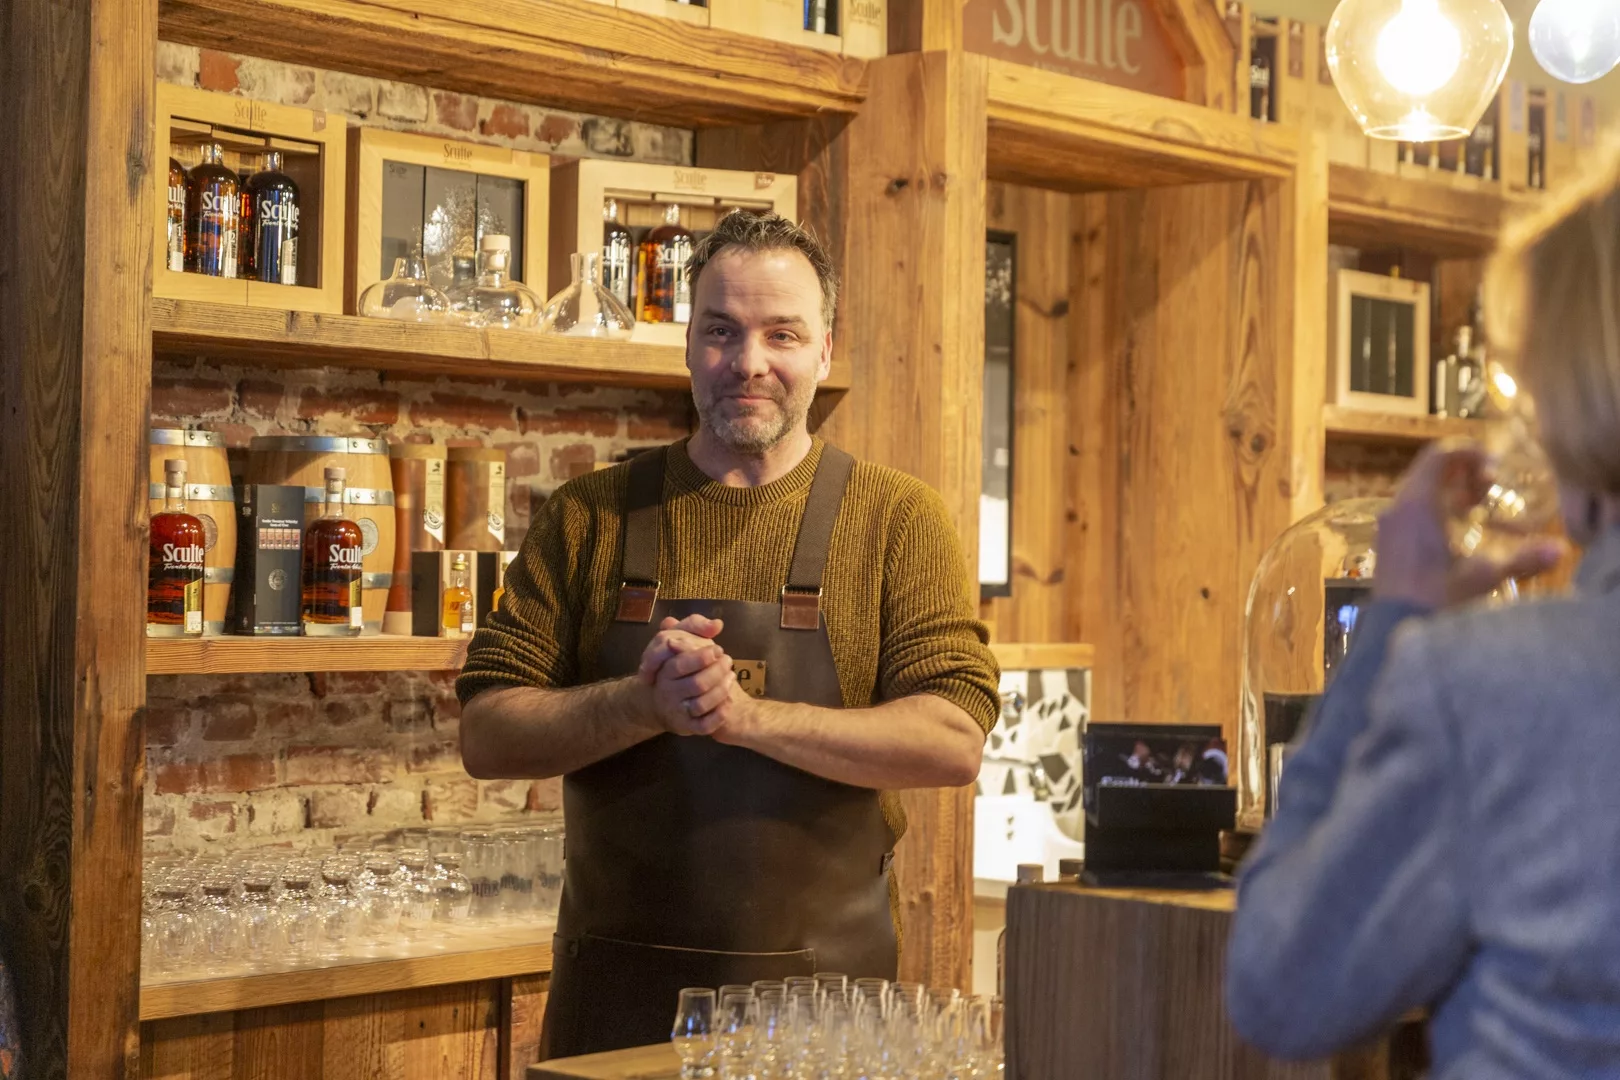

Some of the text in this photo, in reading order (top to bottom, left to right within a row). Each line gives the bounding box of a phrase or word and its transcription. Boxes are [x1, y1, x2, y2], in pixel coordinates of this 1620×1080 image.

[261, 200, 300, 223] Sculte
[163, 543, 204, 563] Sculte
[329, 543, 362, 563] Scult
